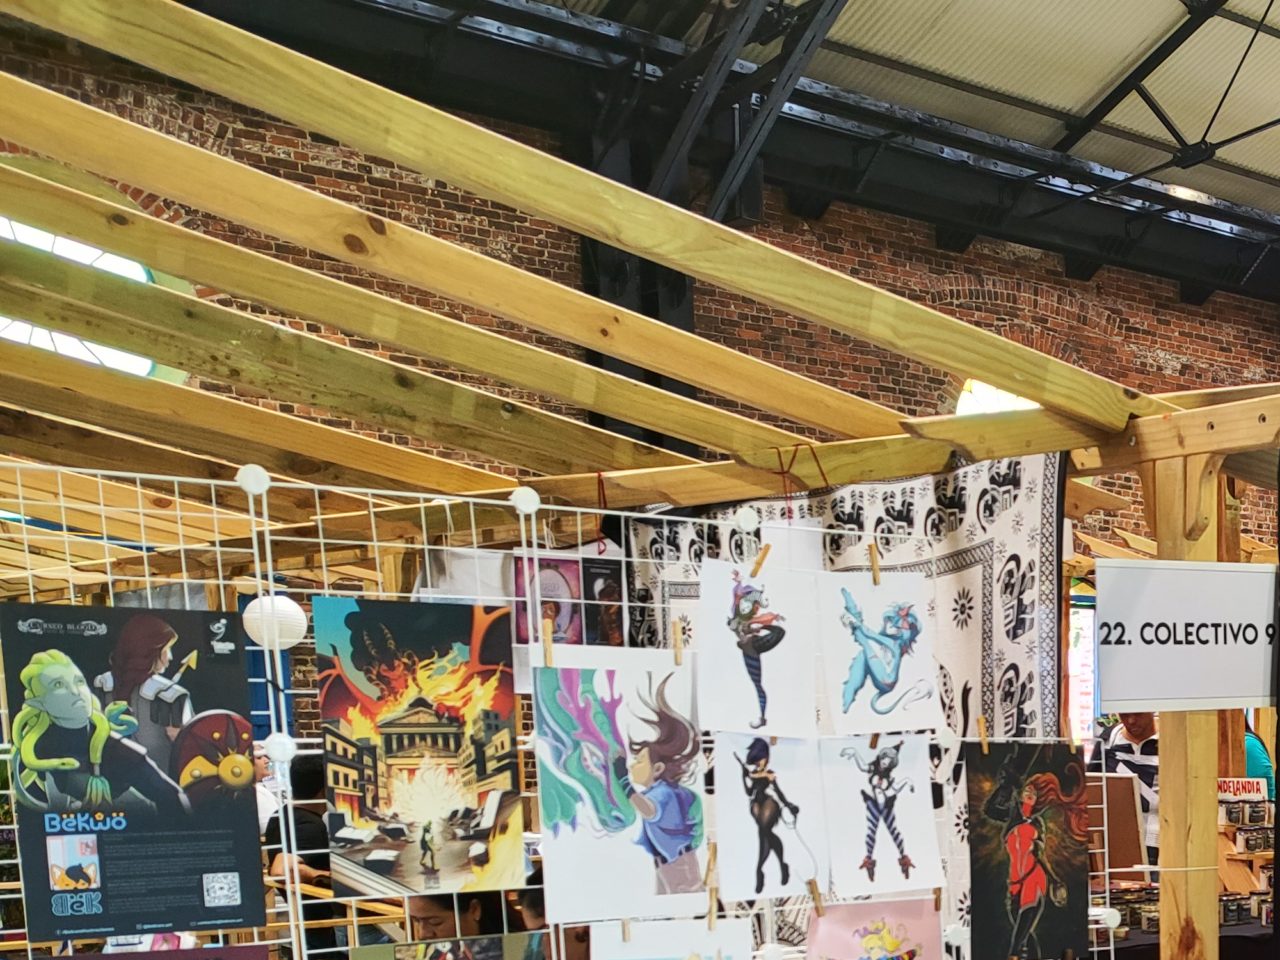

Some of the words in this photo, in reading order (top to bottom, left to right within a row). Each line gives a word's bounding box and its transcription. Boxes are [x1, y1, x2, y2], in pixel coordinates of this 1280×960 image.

[1099, 621, 1132, 645] 22.
[1140, 621, 1259, 645] COLECTIVO
[1265, 623, 1276, 645] 9
